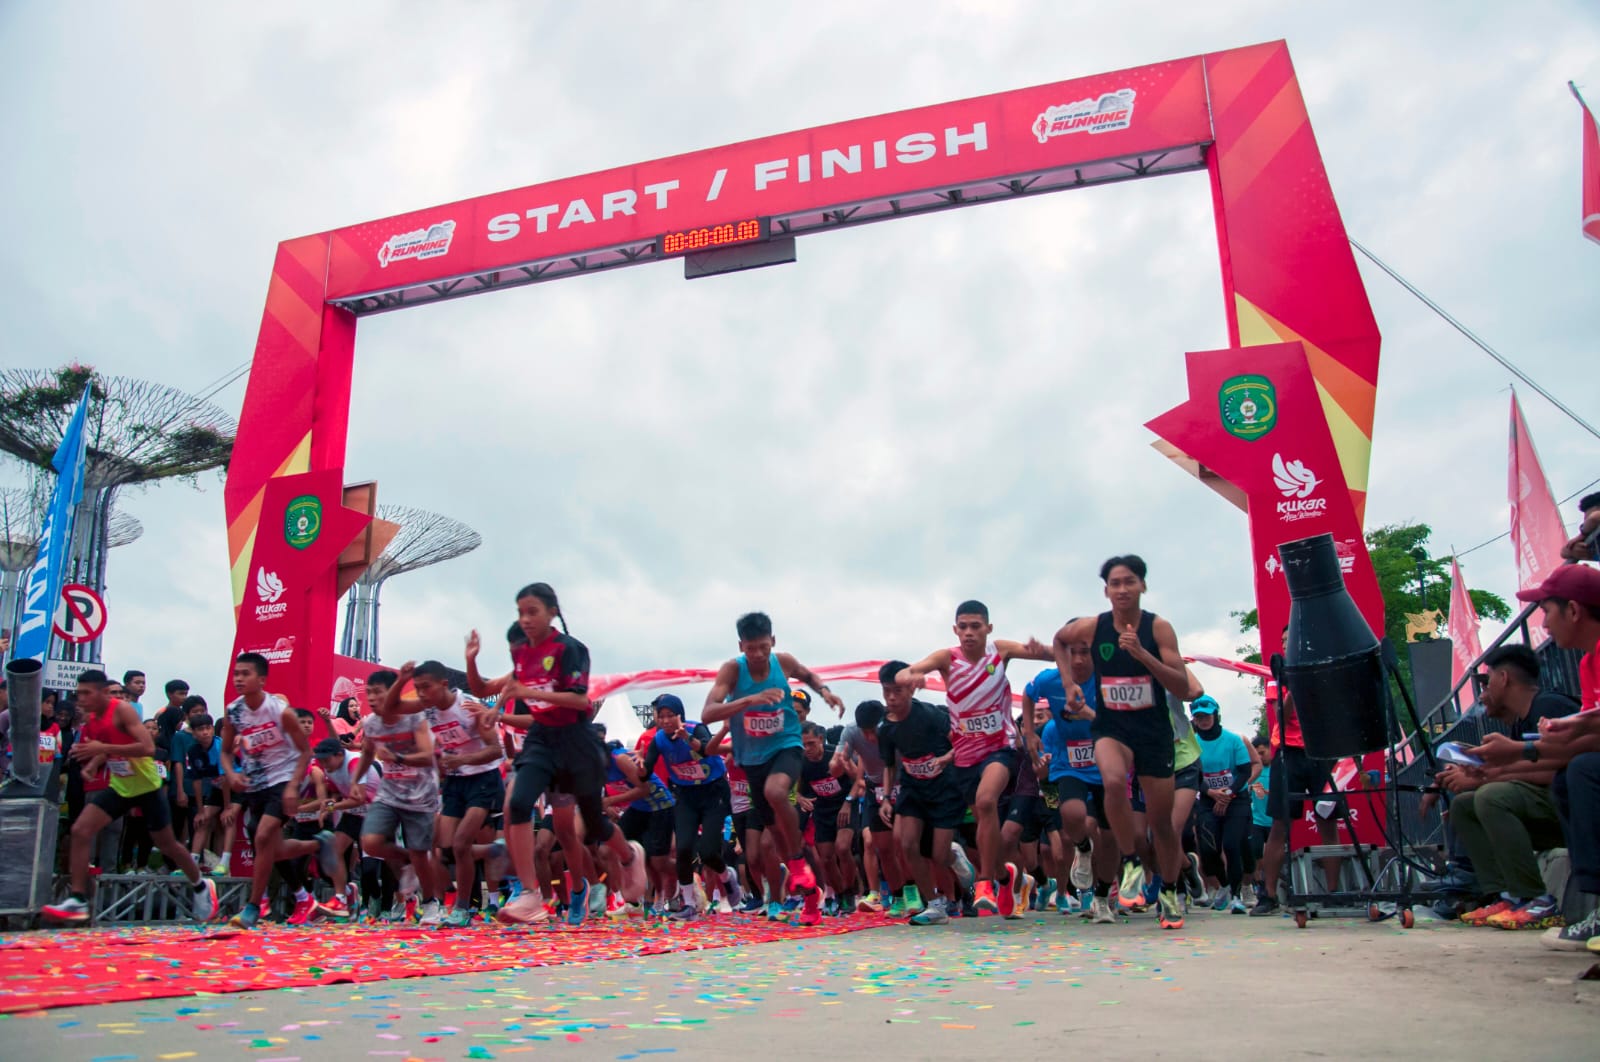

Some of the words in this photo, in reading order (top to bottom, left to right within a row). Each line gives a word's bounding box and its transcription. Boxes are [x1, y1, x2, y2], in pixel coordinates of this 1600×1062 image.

[1050, 109, 1128, 132] RUNNING
[487, 179, 680, 242] START
[706, 168, 728, 202] /
[754, 121, 988, 191] FINISH
[664, 220, 759, 254] 00:00:00.00
[390, 238, 449, 258] RUNNING
[1110, 686, 1143, 702] 0027
[966, 714, 997, 731] 0933
[1074, 746, 1096, 761] 027
[1207, 776, 1230, 788] 1658
